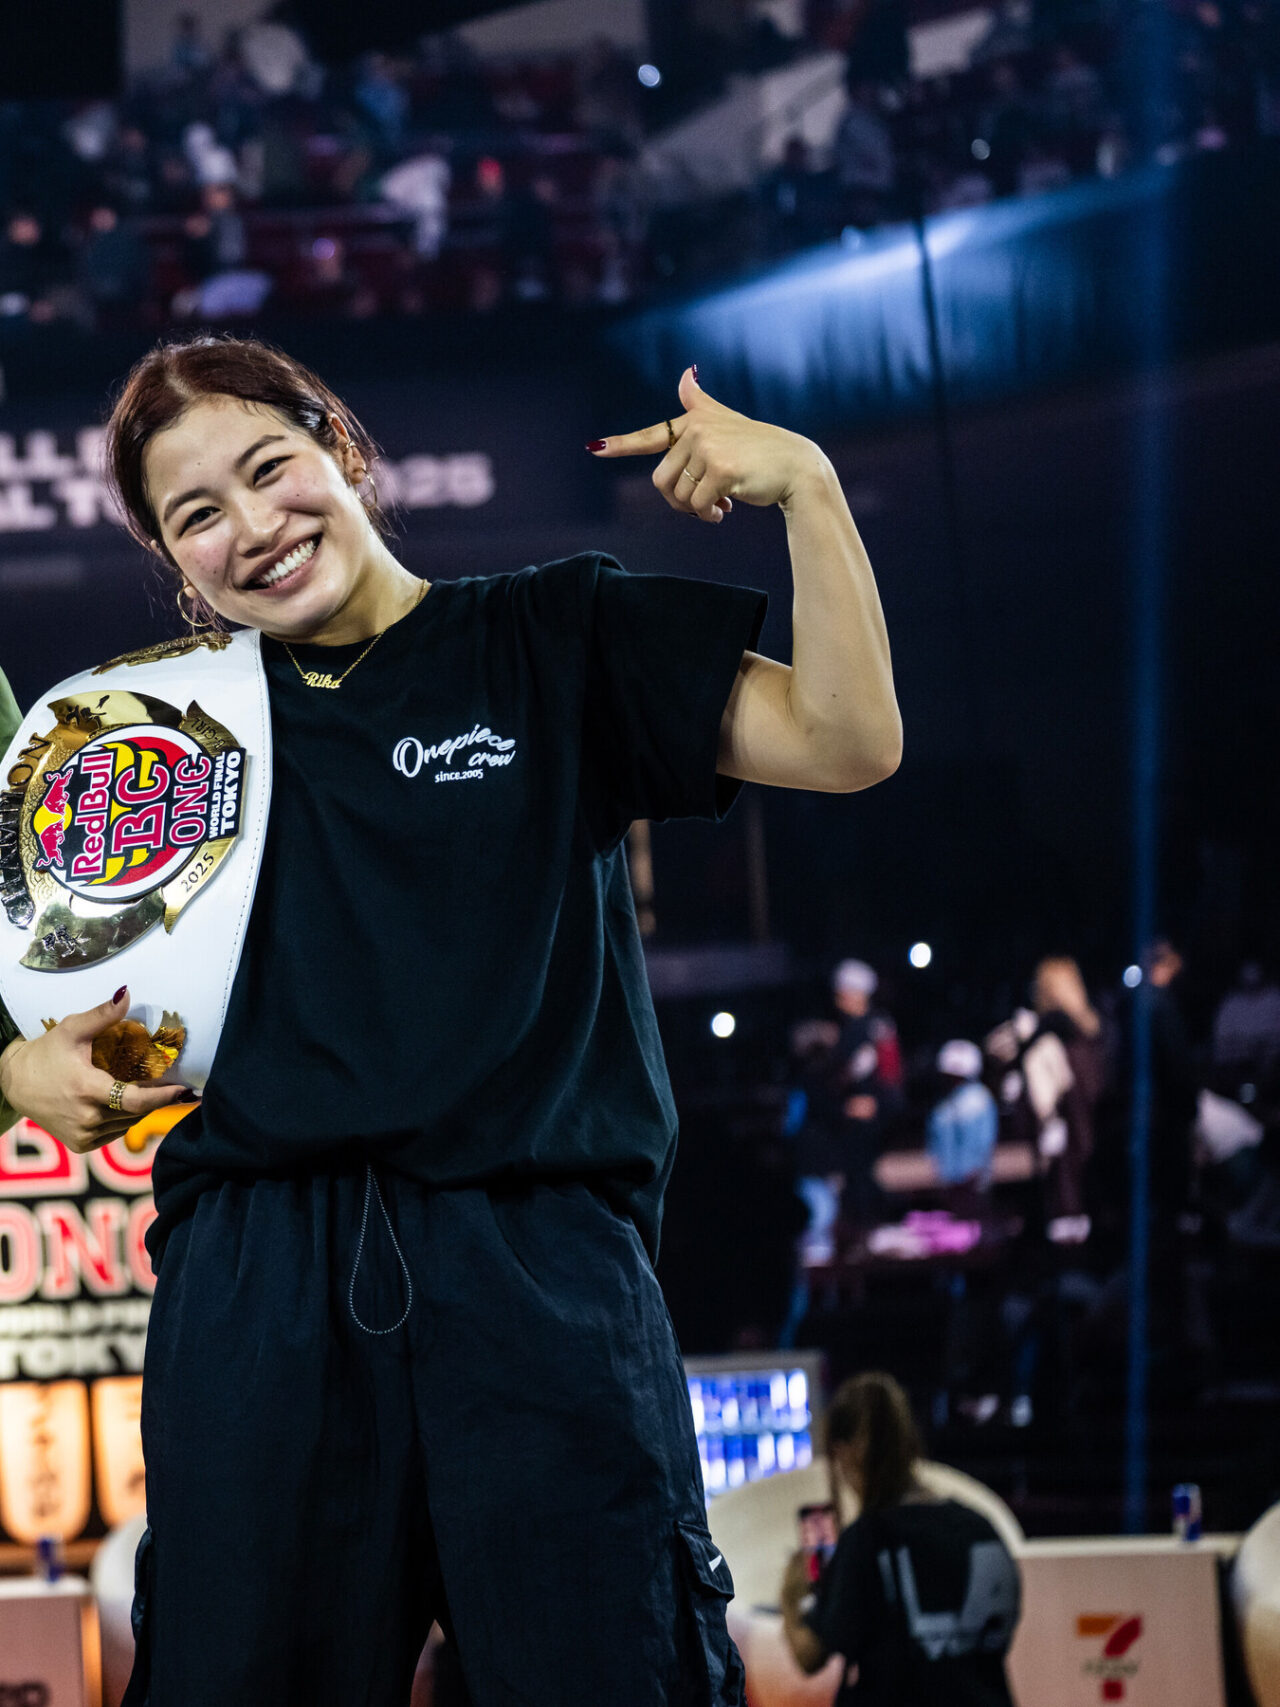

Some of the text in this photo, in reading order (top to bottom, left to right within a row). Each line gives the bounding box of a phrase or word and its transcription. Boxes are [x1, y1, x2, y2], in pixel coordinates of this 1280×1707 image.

[302, 671, 342, 690] Rika
[170, 755, 212, 845] ONE
[208, 751, 226, 839] WORLD FINAL
[220, 750, 242, 836] TOKYO
[468, 750, 516, 767] crew
[71, 751, 114, 878] Red Bull
[112, 763, 171, 854] BC
[180, 850, 215, 893] 2025
